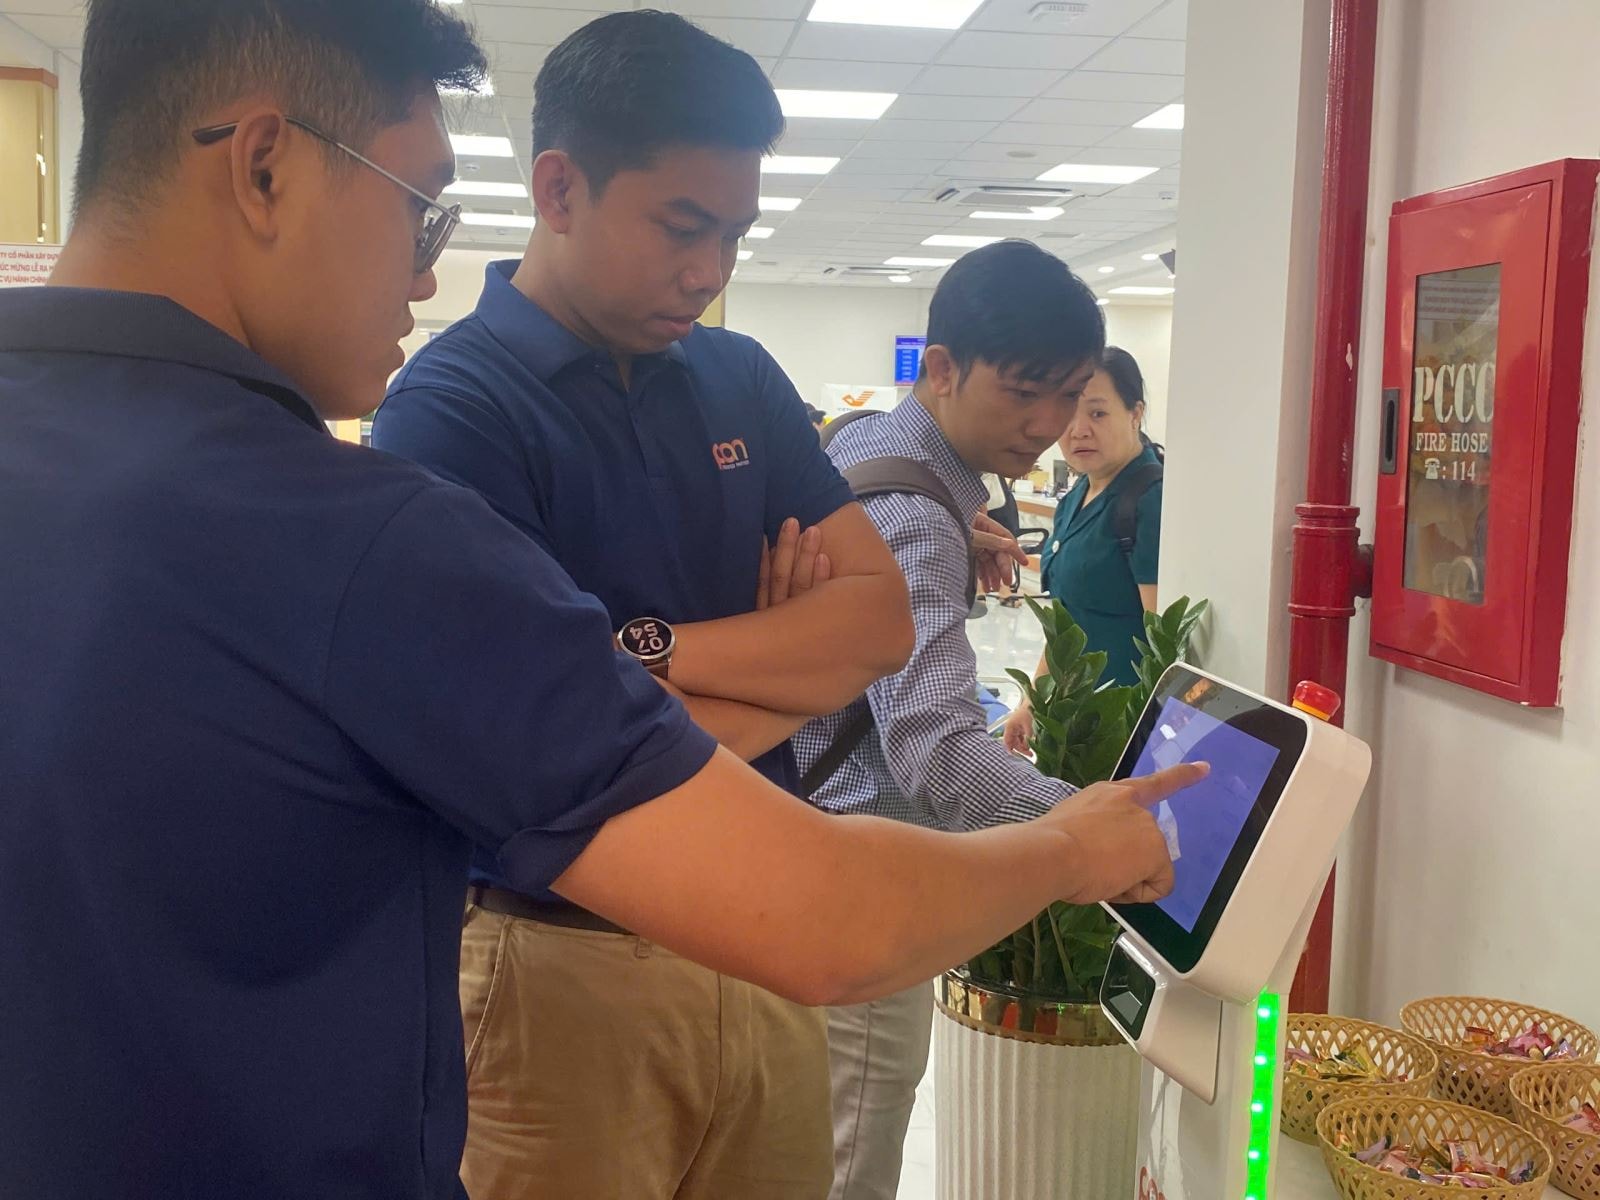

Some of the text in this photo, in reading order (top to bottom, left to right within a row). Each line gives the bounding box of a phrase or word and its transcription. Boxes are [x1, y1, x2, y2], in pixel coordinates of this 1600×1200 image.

[1412, 361, 1496, 424] PCCC
[1416, 432, 1489, 454] FIRE HOSE
